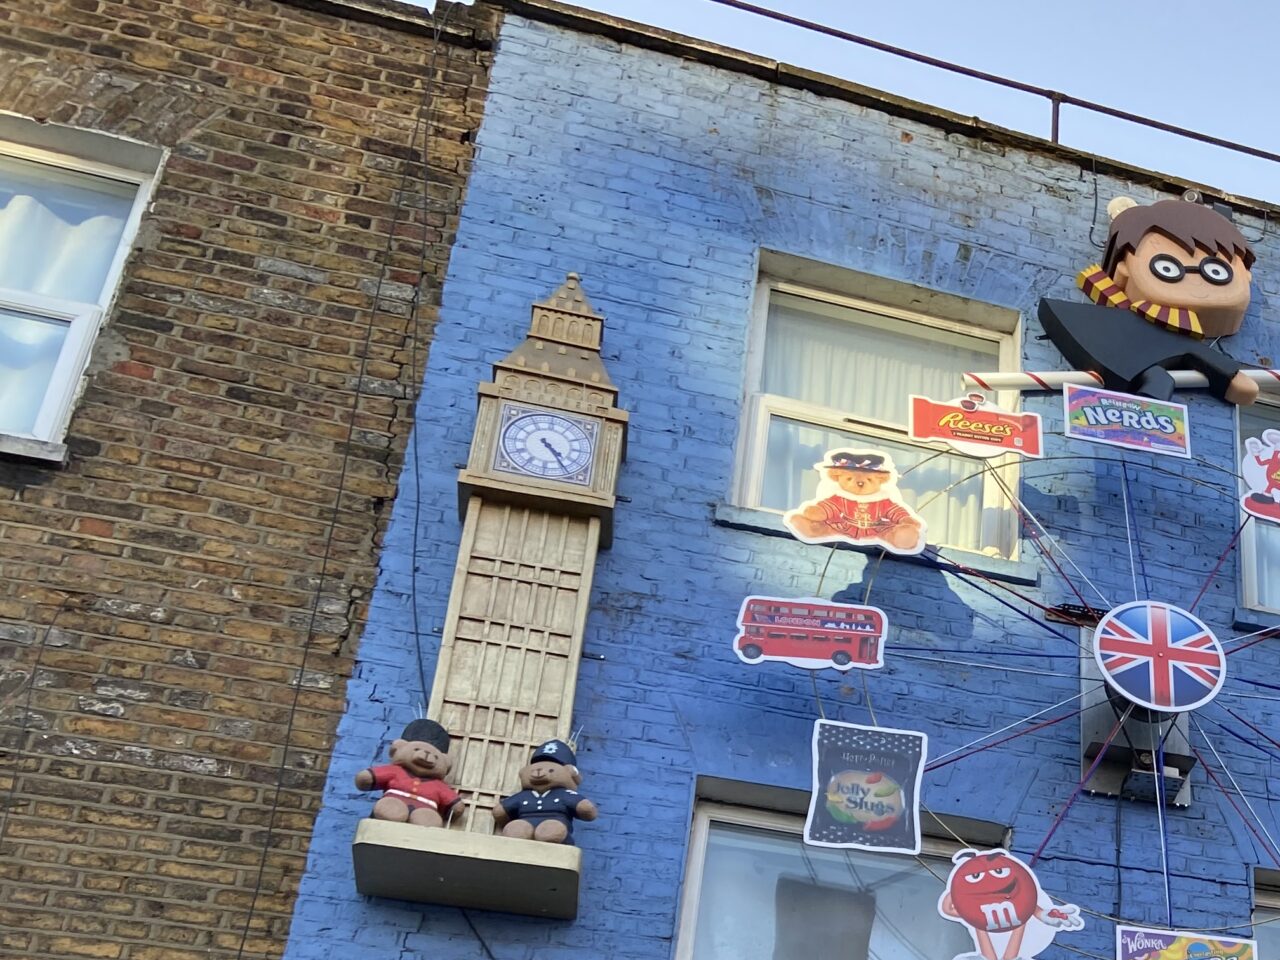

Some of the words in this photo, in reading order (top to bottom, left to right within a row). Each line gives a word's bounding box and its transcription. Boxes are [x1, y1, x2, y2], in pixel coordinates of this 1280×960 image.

[939, 411, 1012, 437] Reese's
[774, 616, 821, 627] LONDON
[835, 782, 871, 798] Jolly
[846, 798, 895, 816] Slugs
[1121, 932, 1168, 954] WONKA
